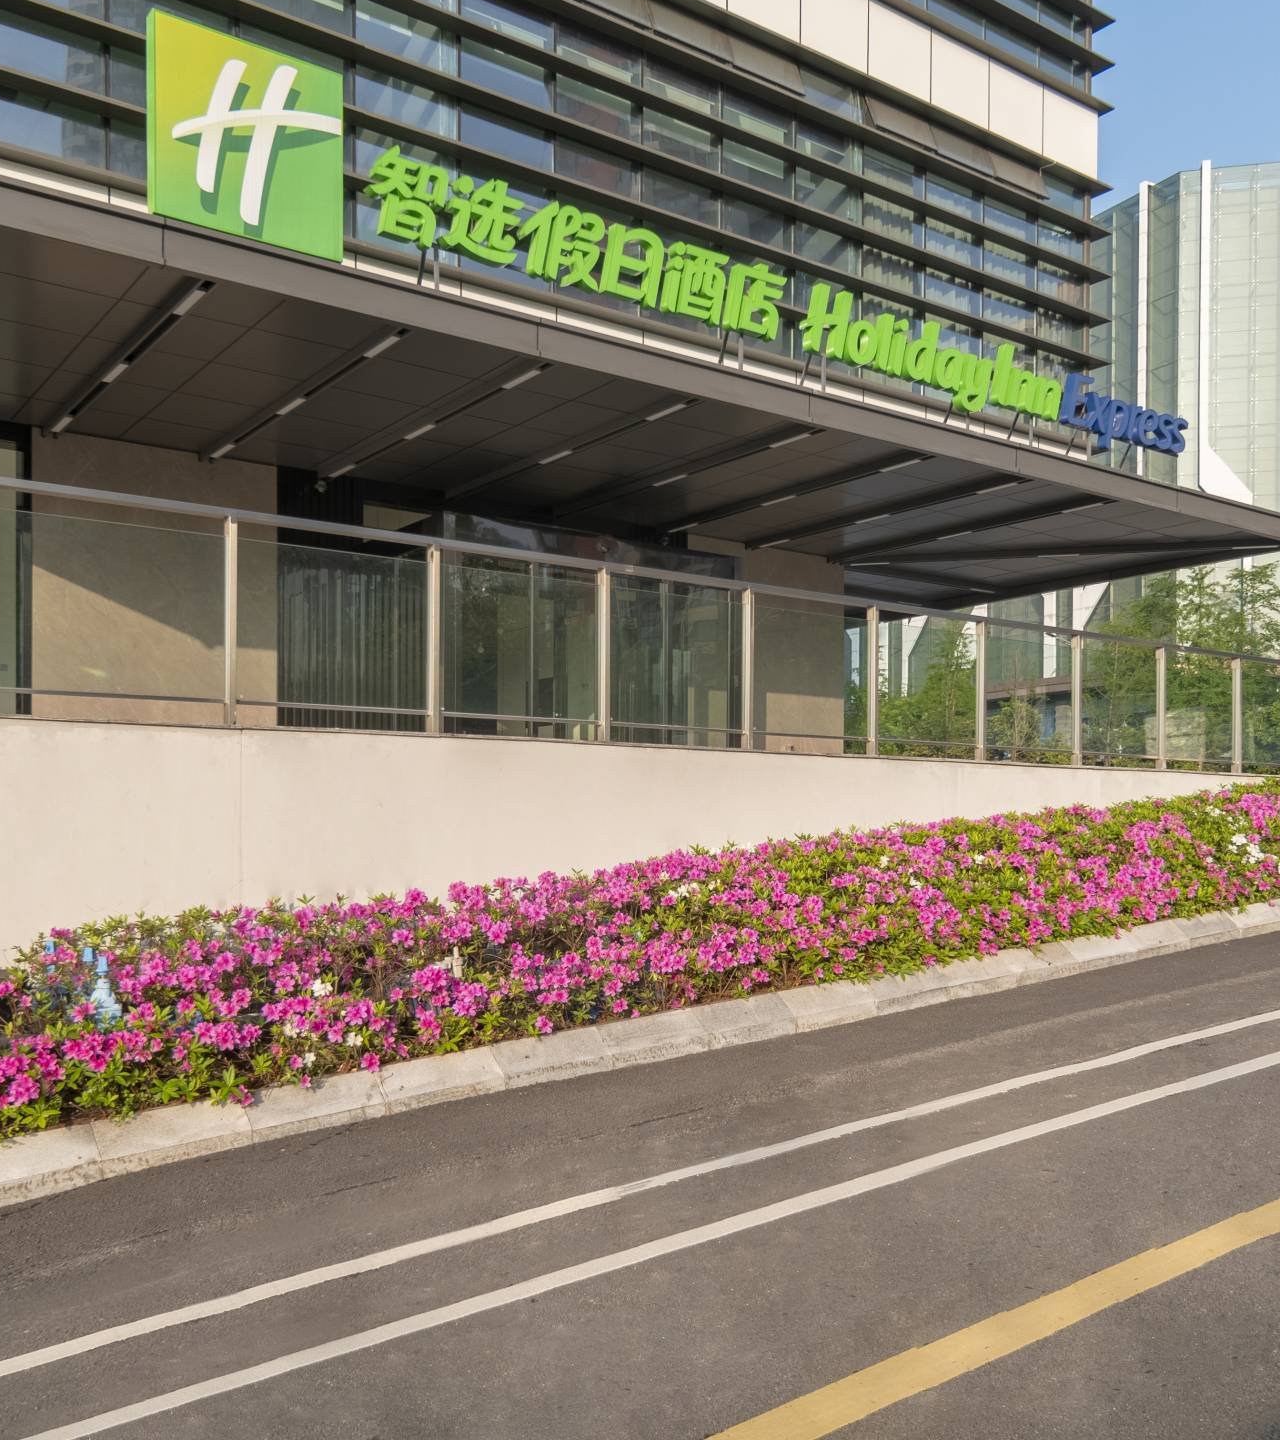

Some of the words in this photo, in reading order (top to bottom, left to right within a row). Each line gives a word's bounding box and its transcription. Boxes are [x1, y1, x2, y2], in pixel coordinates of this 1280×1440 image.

[363, 144, 788, 342] 智选假日酒店
[799, 282, 994, 414] Holiday
[1059, 372, 1190, 456] Express
